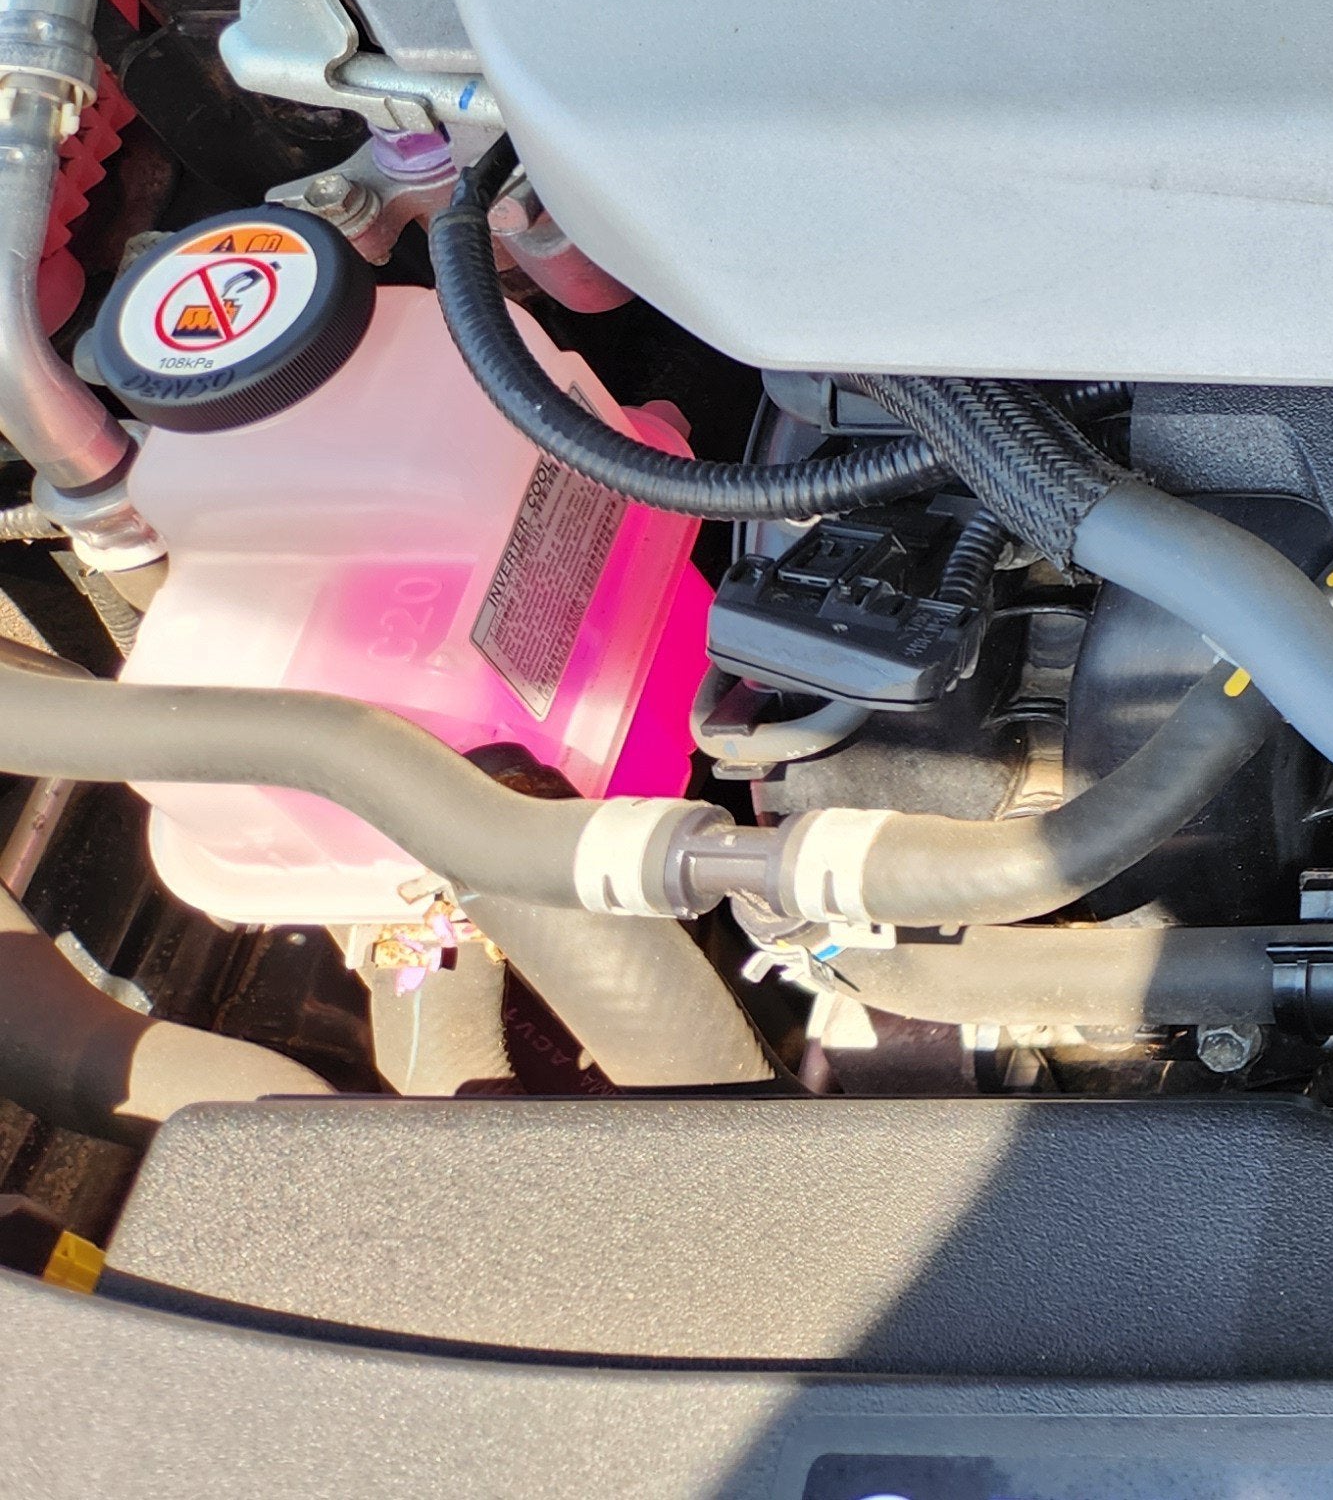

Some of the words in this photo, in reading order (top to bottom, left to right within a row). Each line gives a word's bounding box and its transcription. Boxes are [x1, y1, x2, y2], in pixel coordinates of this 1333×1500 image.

[159, 357, 215, 370] 108kPa
[120, 367, 235, 400] DENSO
[488, 516, 529, 609] INVERTER
[526, 460, 553, 510] COOL
